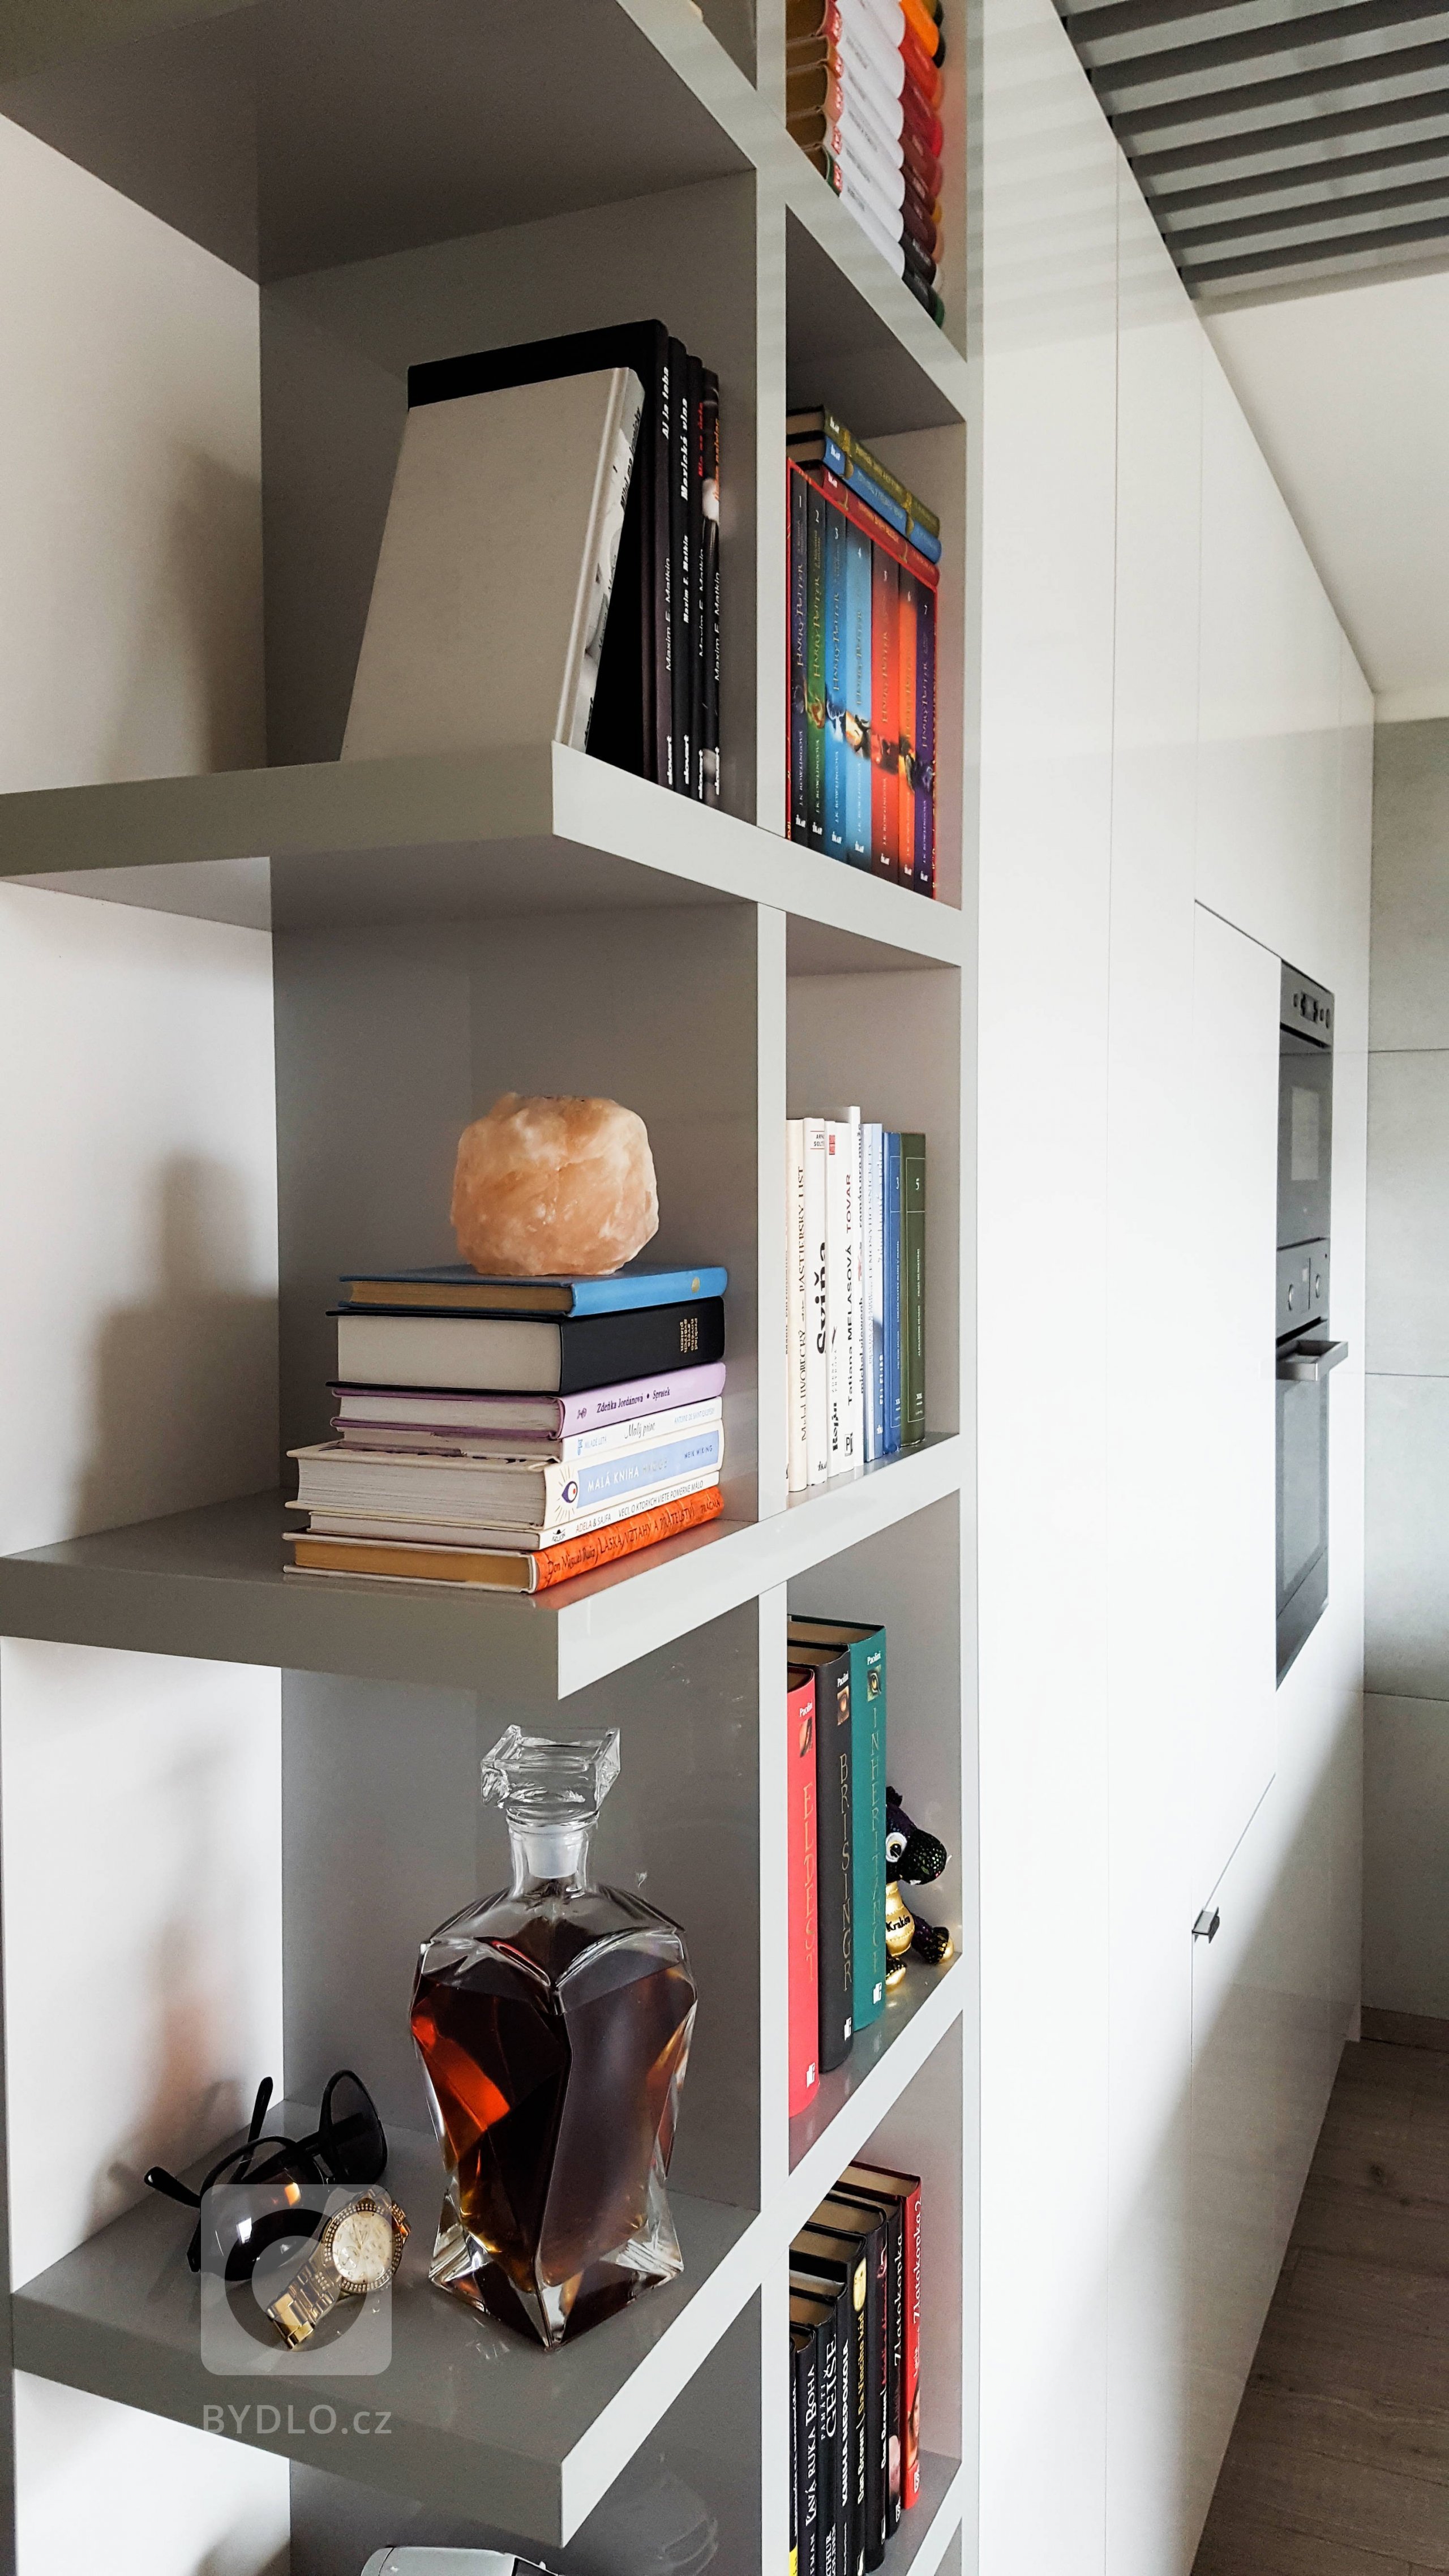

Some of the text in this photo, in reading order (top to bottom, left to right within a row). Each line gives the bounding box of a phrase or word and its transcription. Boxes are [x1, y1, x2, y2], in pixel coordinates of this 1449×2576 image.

[662, 421, 669, 439] Aj
[680, 434, 688, 501] Mexická
[624, 1422, 655, 1439] Malý princ
[684, 1451, 695, 1459] MEIK
[588, 1471, 611, 1492] MALÁ
[614, 1466, 640, 1484] KNIHA
[631, 1505, 636, 1513] O
[576, 1520, 592, 1533] ADELA
[593, 1518, 597, 1527] &
[561, 1551, 581, 1570] Miguel
[625, 1525, 651, 1543] VZTAHY
[654, 1521, 659, 1531] A
[867, 1651, 881, 1665] Paolini
[837, 1670, 849, 1687] Paolini
[799, 1699, 813, 1717] Paolini
[839, 1752, 854, 1992] BRISINGR
[914, 2196, 921, 2211] 2
[913, 2211, 921, 2324] Zlatokopka
[894, 2232, 903, 2366] Zlatokopka
[805, 2363, 817, 2427] BOHA
[823, 2333, 837, 2437] GEIŠE
[858, 2391, 864, 2415] Da
